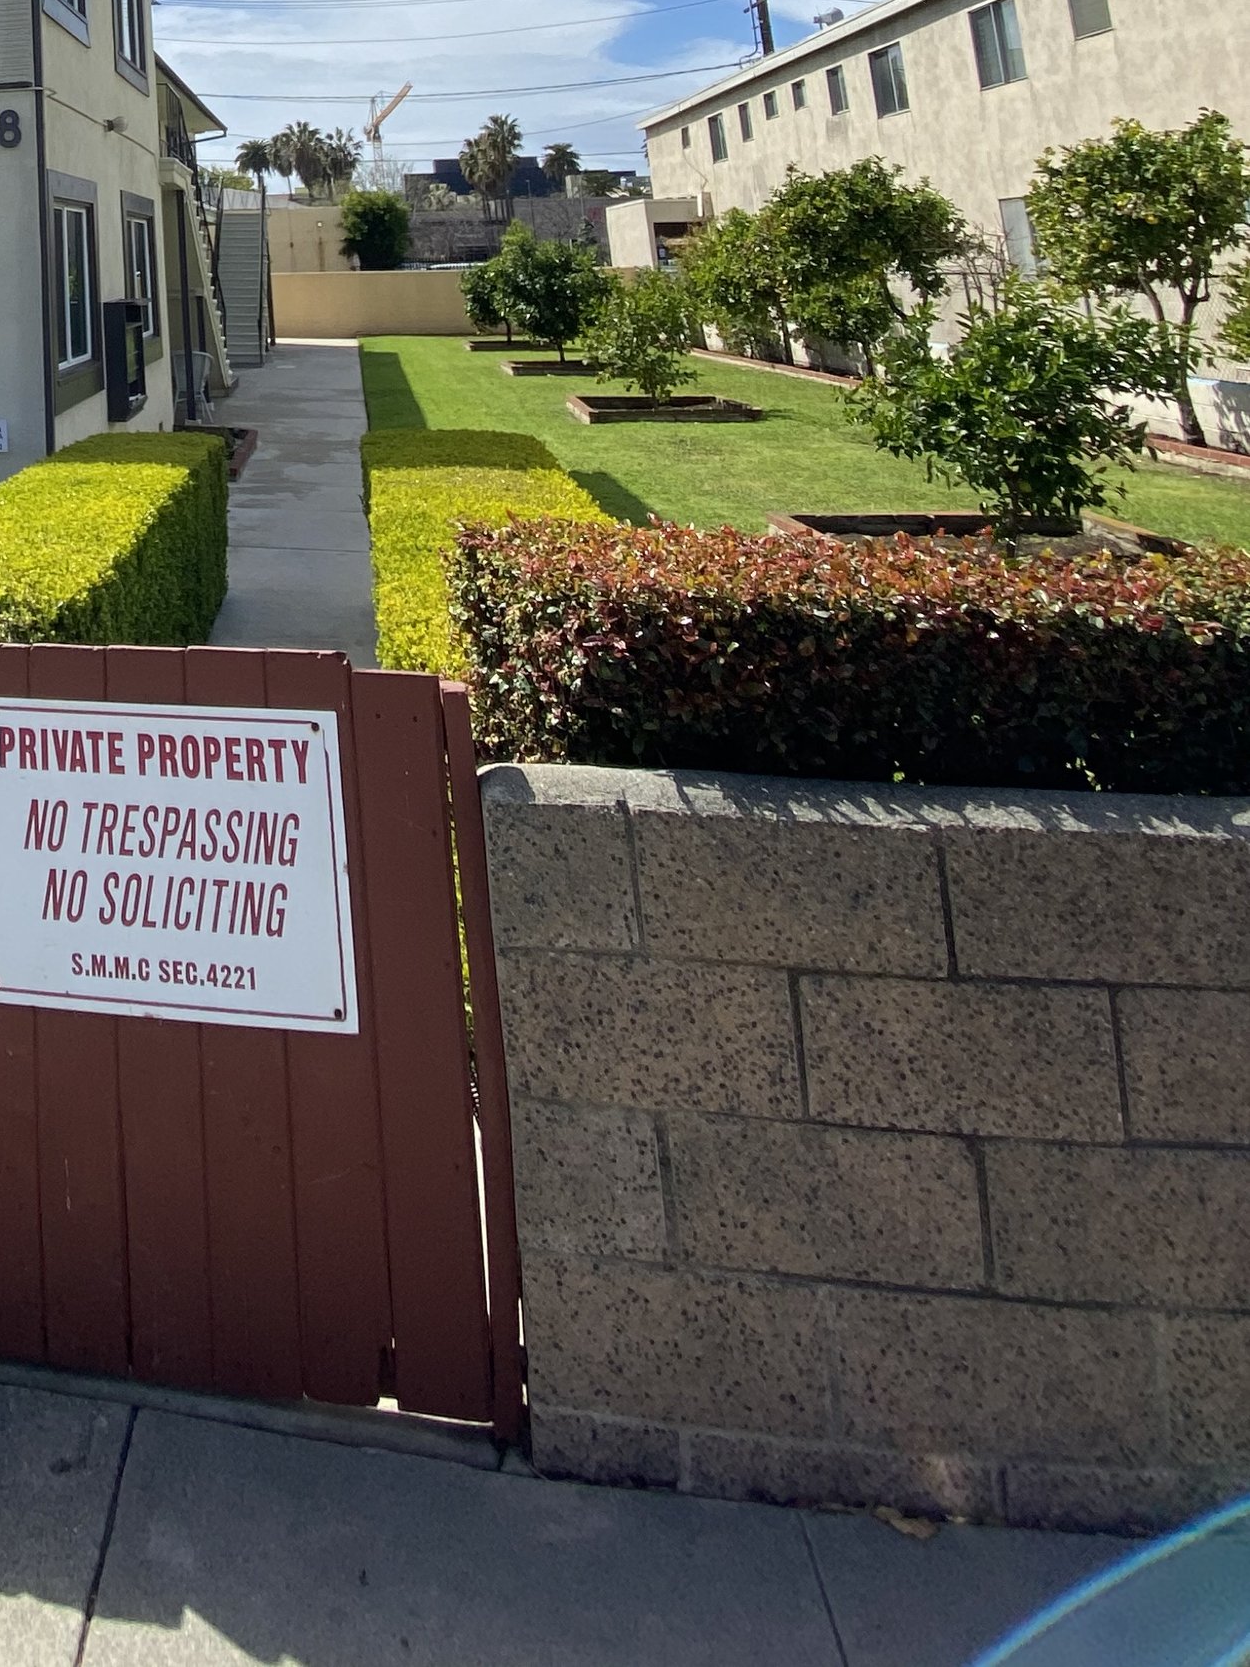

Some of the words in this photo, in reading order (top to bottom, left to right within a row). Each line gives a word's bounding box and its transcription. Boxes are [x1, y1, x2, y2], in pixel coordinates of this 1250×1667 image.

[137, 732, 310, 784] PROPERTY
[23, 798, 69, 852] NO
[81, 801, 301, 867] TRESPASSING
[42, 868, 88, 923] NO
[98, 871, 288, 938] SOLICITING
[71, 952, 151, 982] S.M.M.C
[158, 959, 257, 991] SEC.4221
